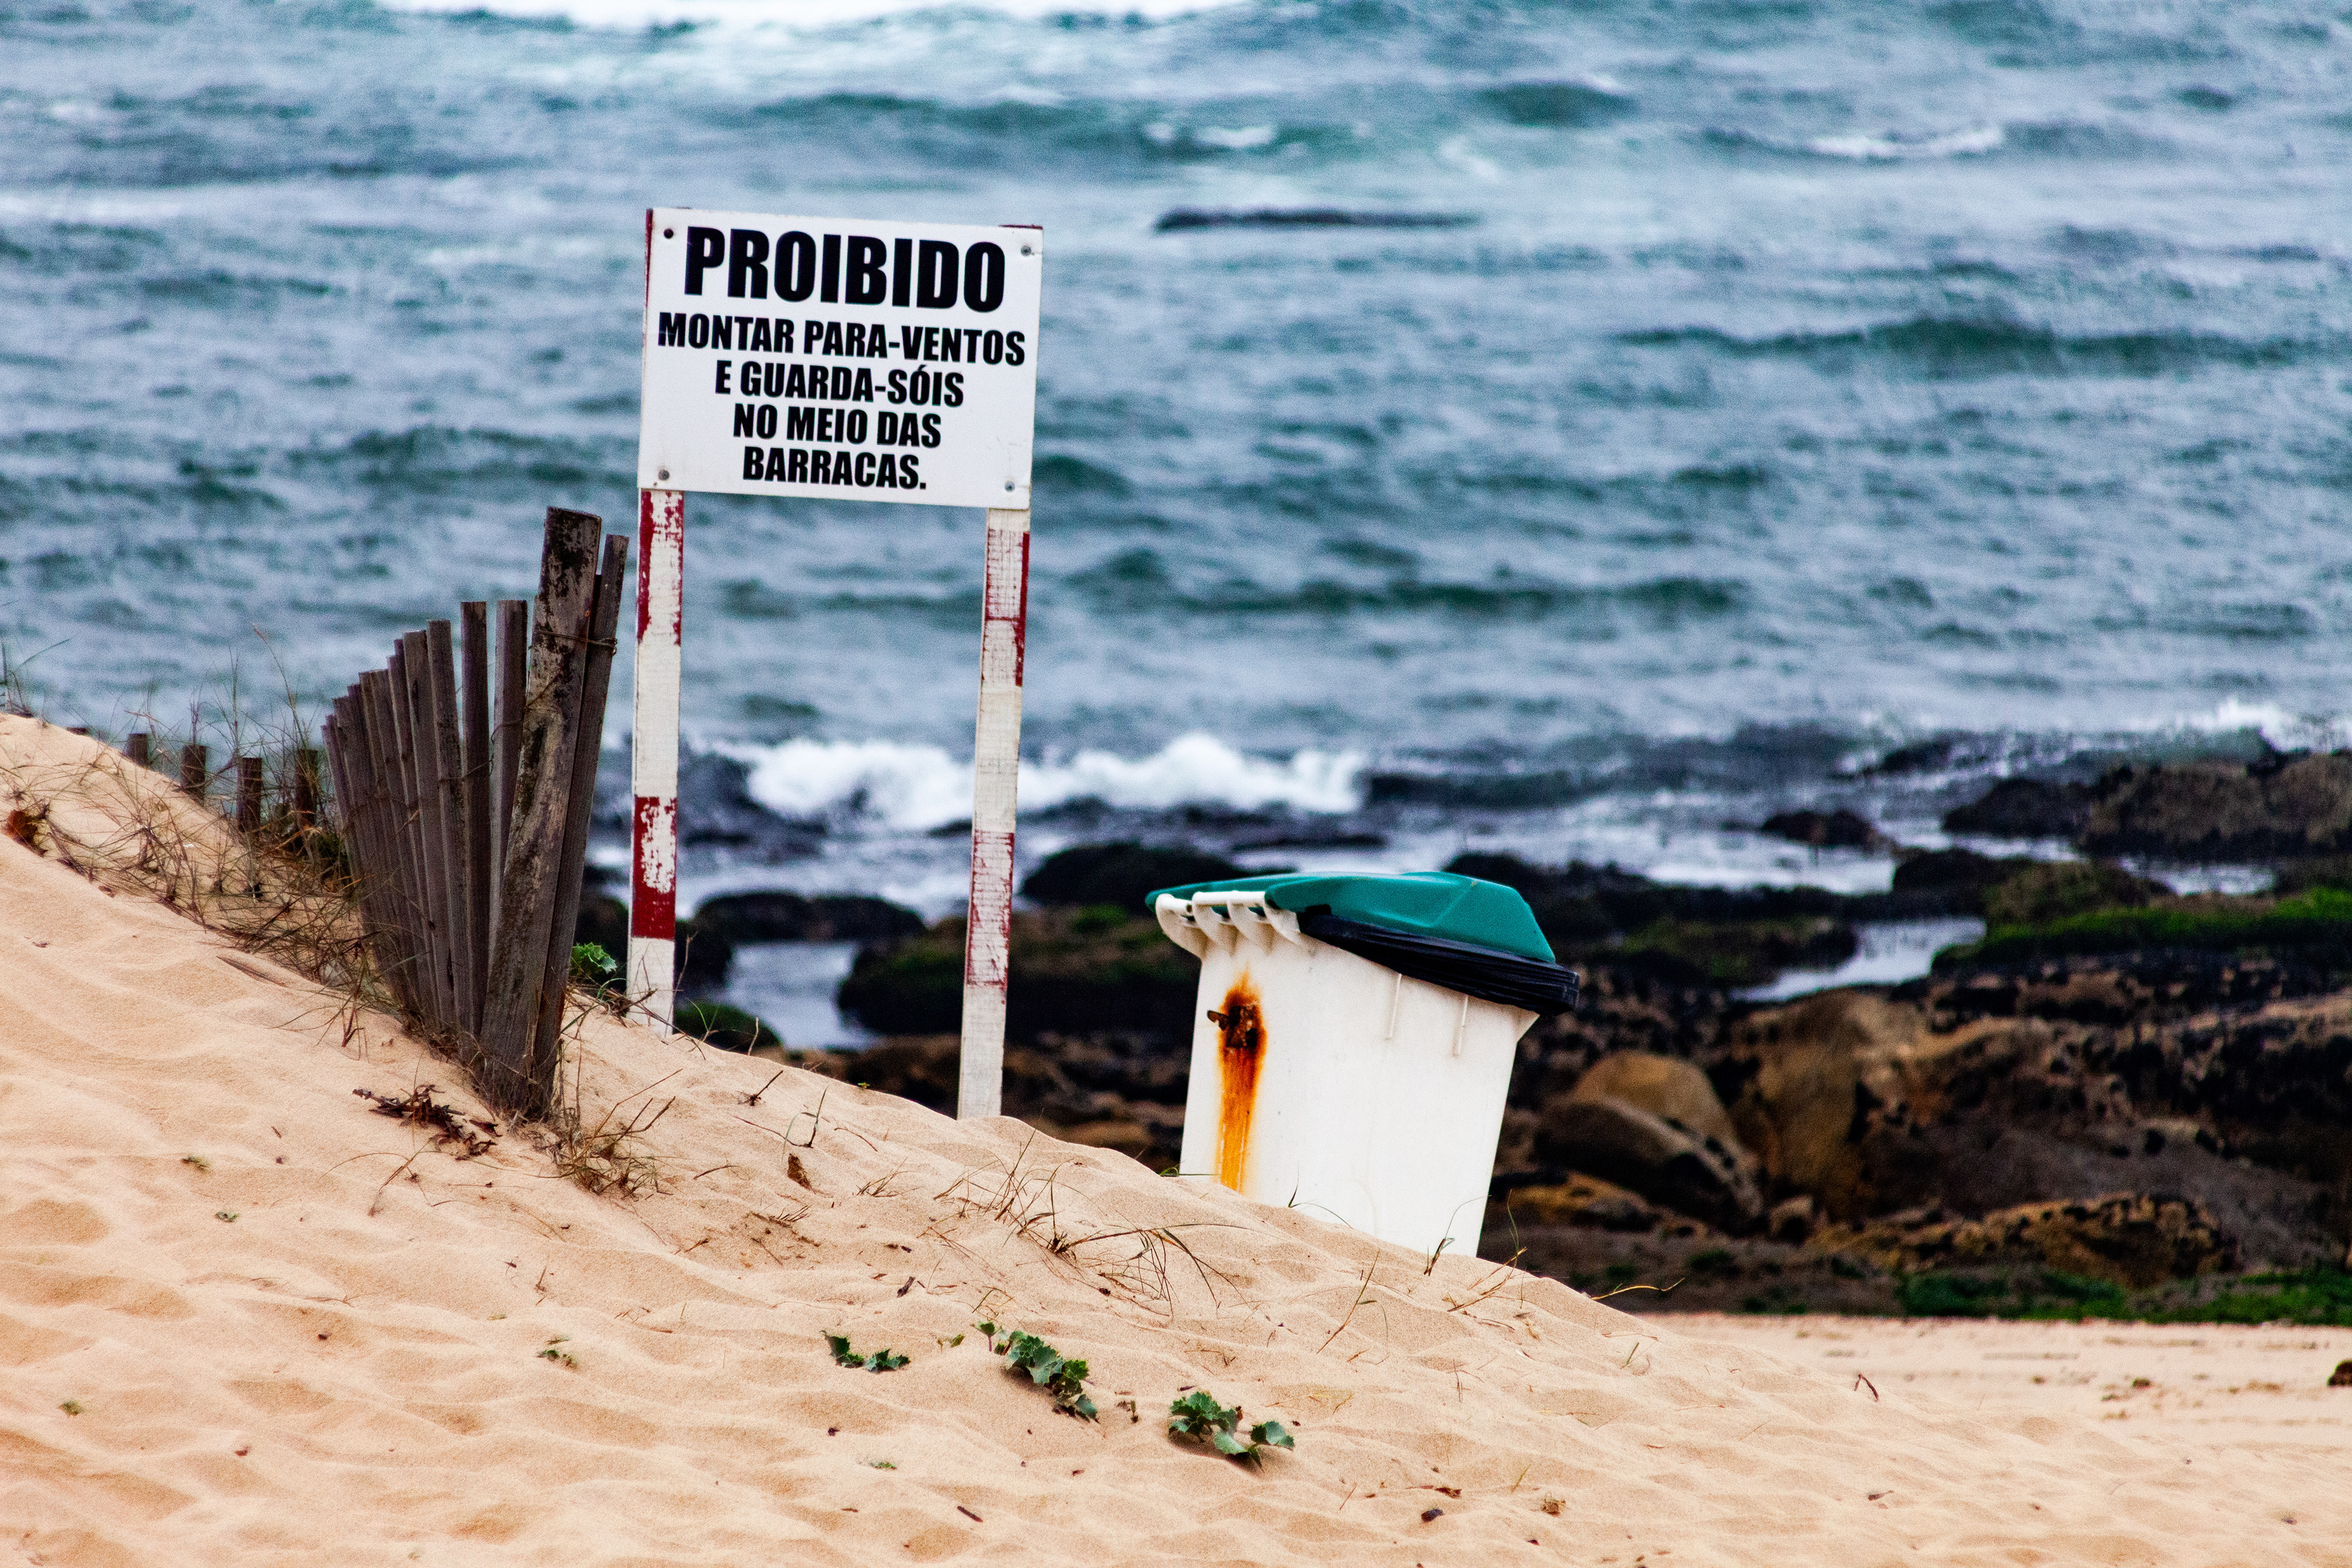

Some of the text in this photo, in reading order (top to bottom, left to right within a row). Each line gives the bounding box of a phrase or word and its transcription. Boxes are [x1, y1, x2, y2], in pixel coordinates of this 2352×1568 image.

[684, 226, 1006, 313] PROIBIDO
[658, 312, 1025, 366] MONTAR PARA-VENTOS
[715, 360, 964, 408] E GUARDA-SÓIS
[733, 403, 941, 449] NO MEIO DAS
[742, 445, 927, 490] BARRACAS.
